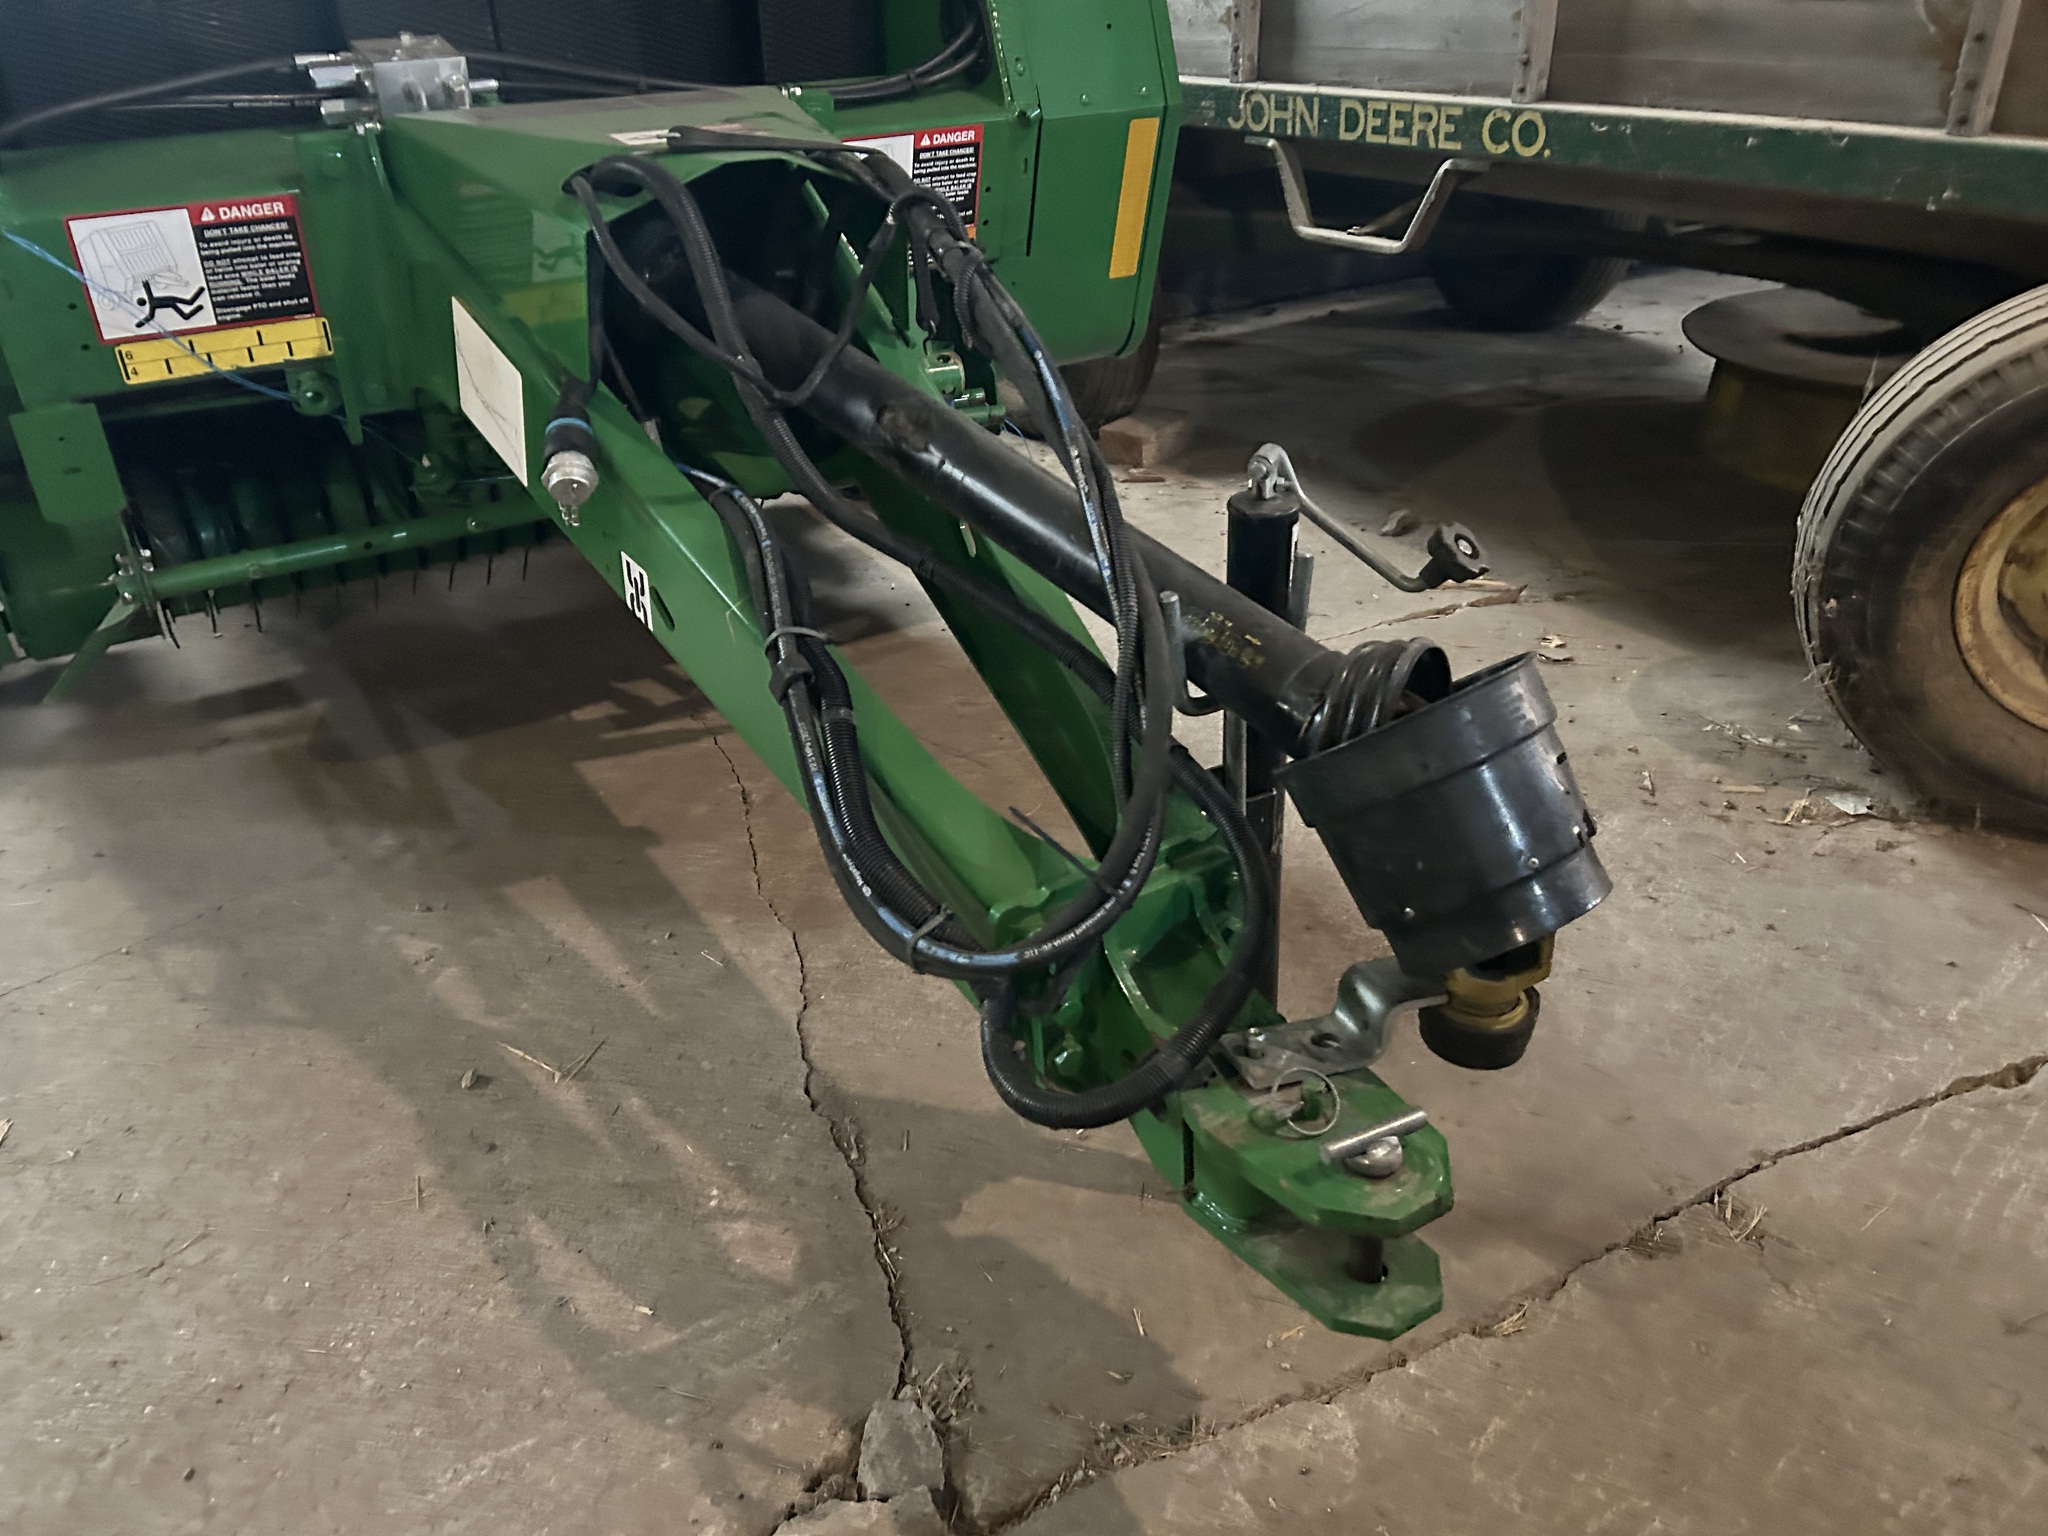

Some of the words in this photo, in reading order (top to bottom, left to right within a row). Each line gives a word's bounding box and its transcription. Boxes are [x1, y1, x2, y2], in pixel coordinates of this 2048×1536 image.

[1228, 90, 1318, 136] JOHN
[1339, 99, 1463, 150] DEERE
[1482, 107, 1550, 158] CO.
[933, 130, 975, 145] DANGER
[920, 151, 934, 160] DON'T
[936, 150, 948, 158] TAKE
[950, 146, 974, 156] CHANCES!
[218, 201, 285, 220] DANGER
[204, 228, 227, 238] DON'T
[228, 226, 249, 235] TAKE
[250, 222, 288, 233] CHANCES!
[210, 240, 229, 248] avoid
[216, 258, 230, 267] NOT
[125, 350, 134, 360] 6
[130, 367, 138, 376] 4
